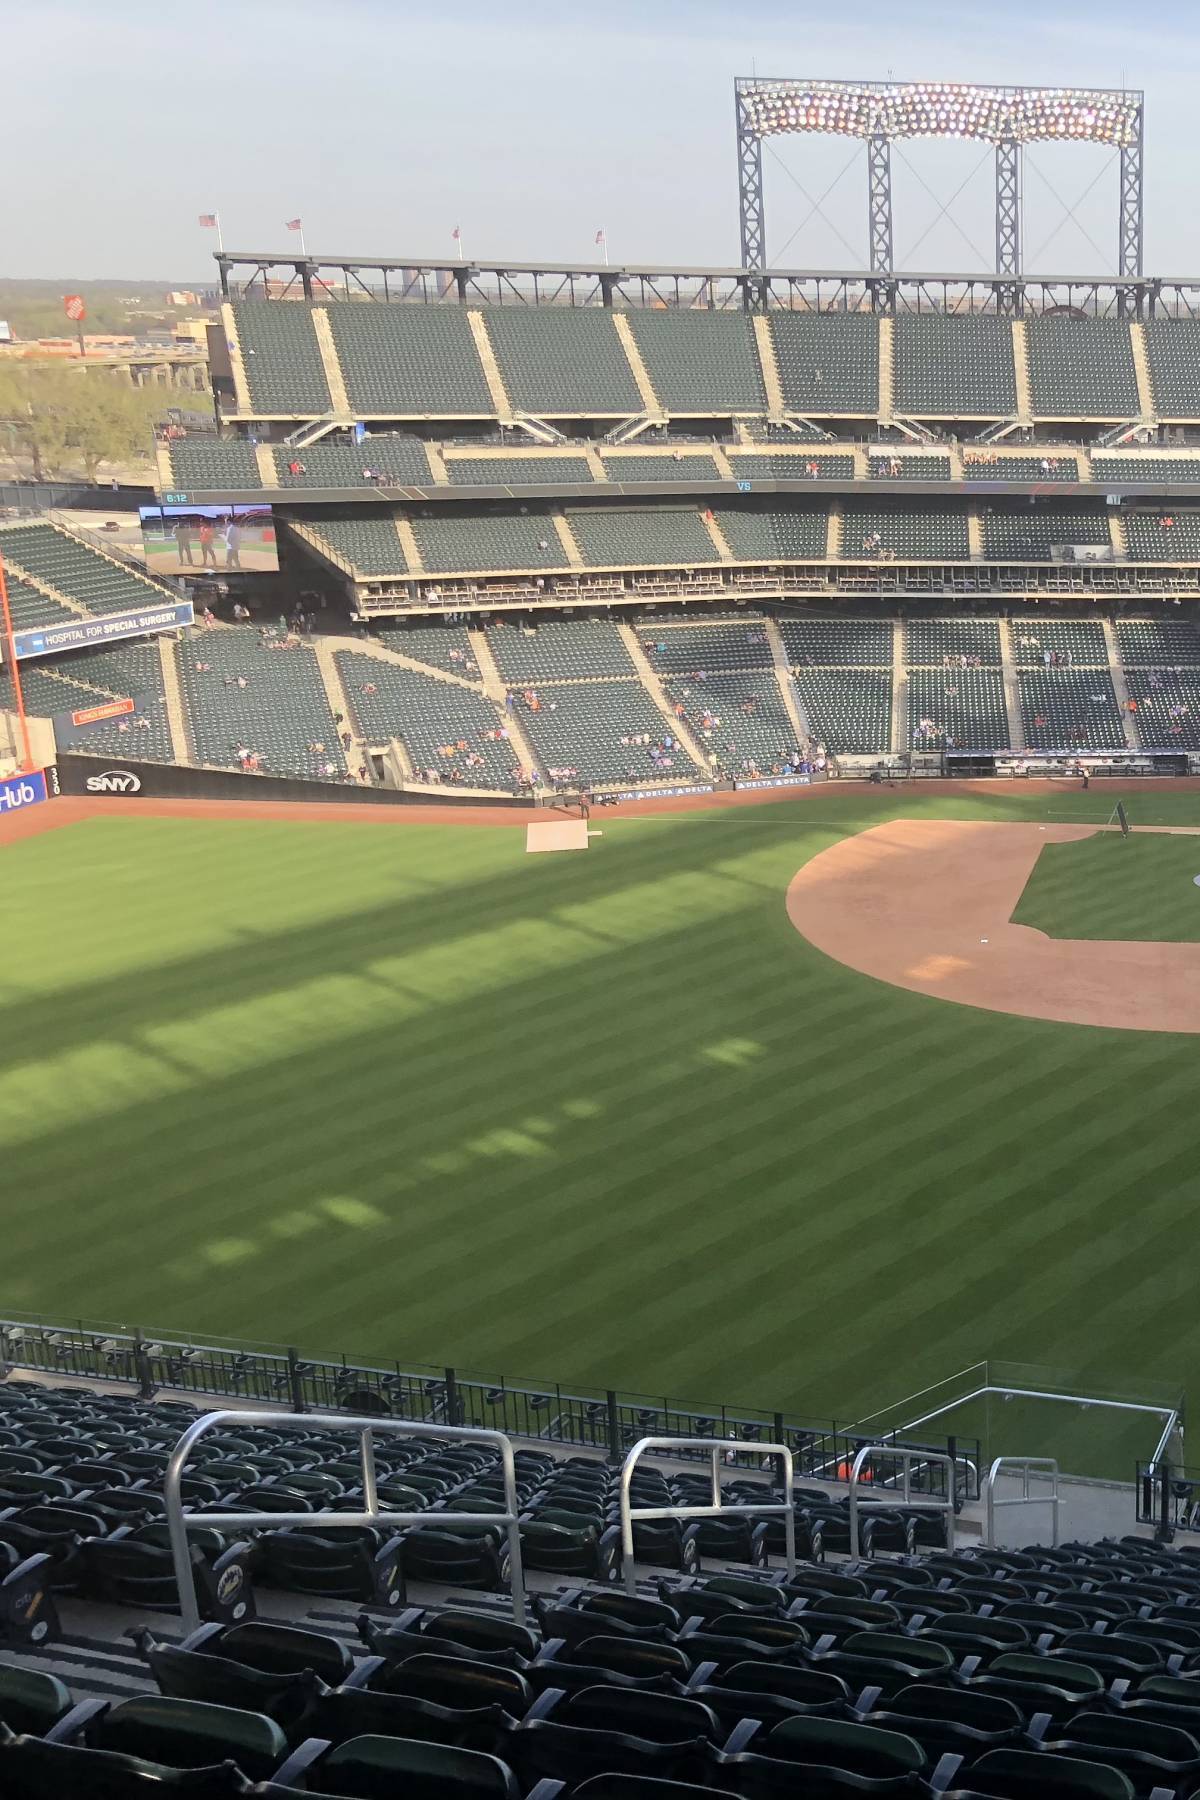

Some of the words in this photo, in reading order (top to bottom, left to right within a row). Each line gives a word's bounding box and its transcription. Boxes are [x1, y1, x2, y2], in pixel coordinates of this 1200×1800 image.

[736, 482, 751, 491] VS
[166, 494, 188, 503] 6:12
[45, 631, 86, 646] HOSPITAL
[86, 627, 103, 637] FOR
[103, 618, 139, 634] SPECIAL
[139, 611, 176, 627] SURGERY
[86, 775, 132, 792] SNY
[746, 780, 773, 788] DELTA
[783, 777, 810, 786] DELTA
[646, 788, 673, 797] DELTA
[685, 785, 713, 793] DELTA
